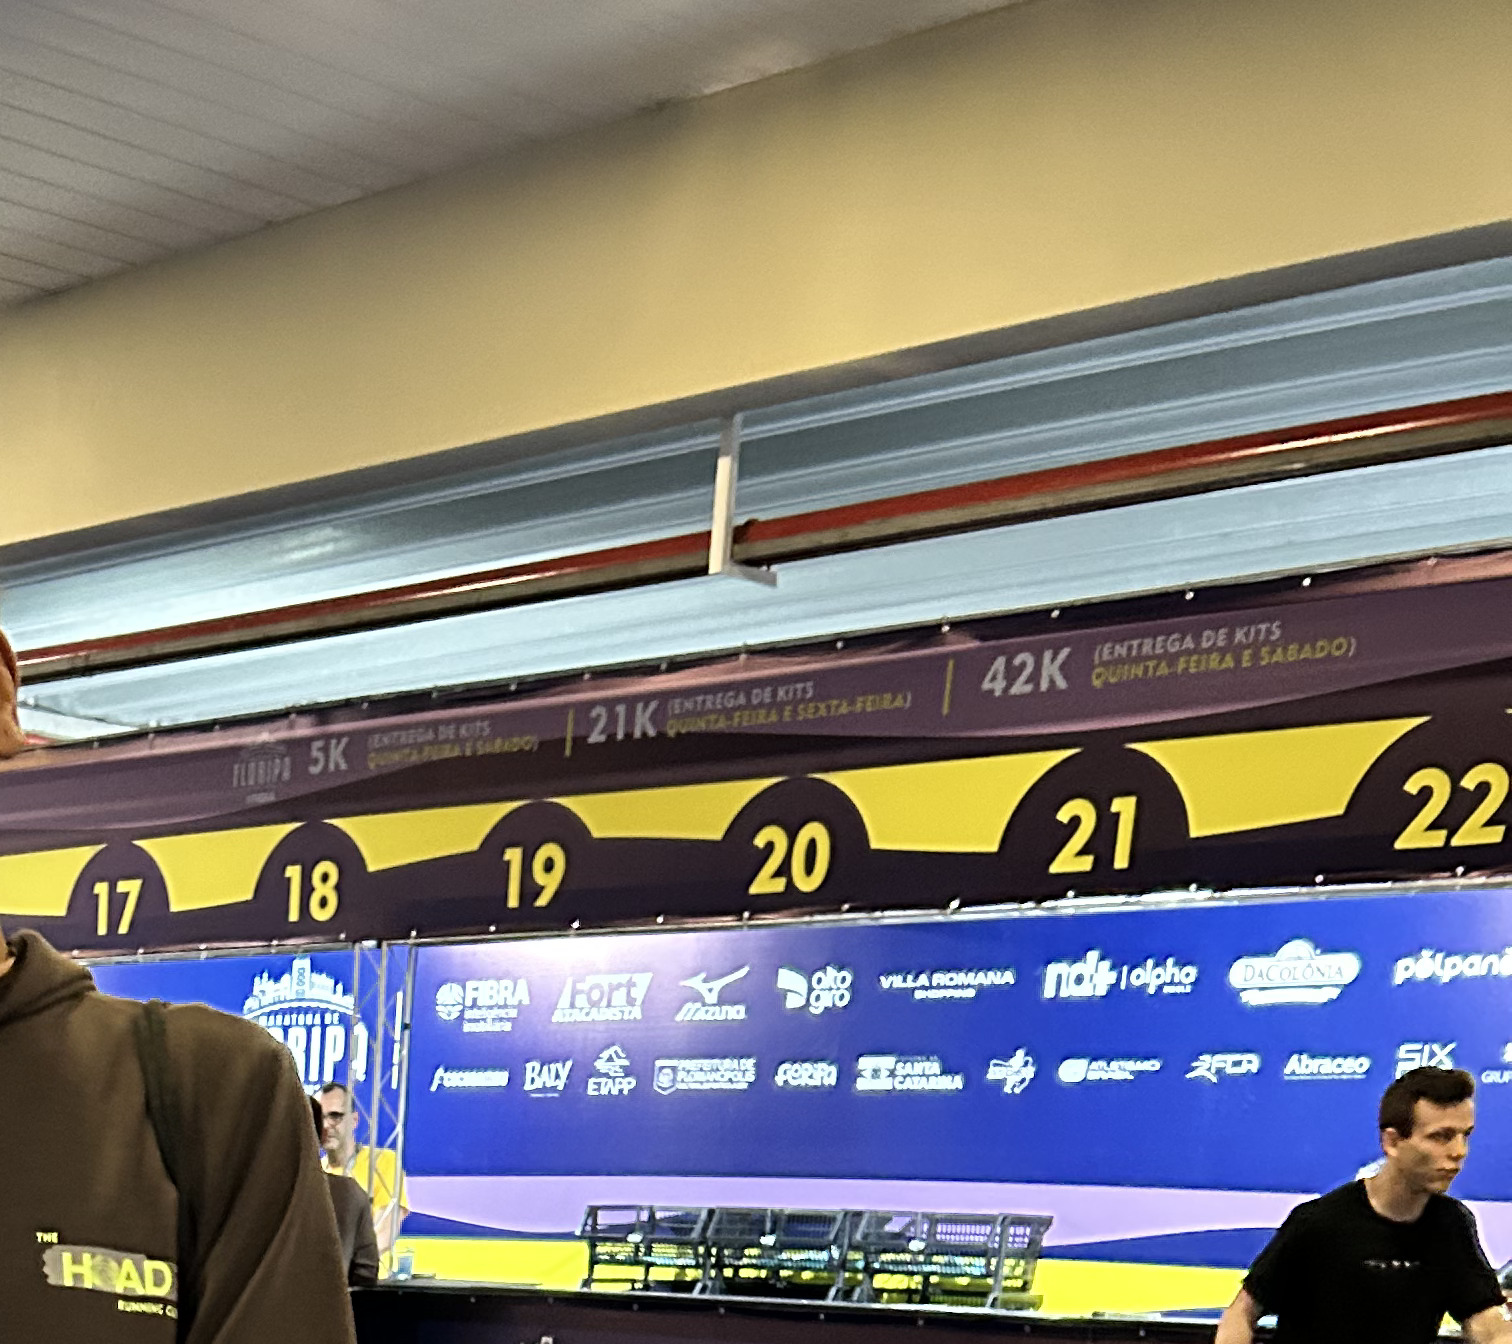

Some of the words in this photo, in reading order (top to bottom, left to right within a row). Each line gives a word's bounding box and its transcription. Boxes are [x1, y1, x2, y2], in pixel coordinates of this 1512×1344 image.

[1201, 628, 1229, 649] DE
[1235, 621, 1282, 644] KITS
[981, 647, 1072, 697] 42K
[1241, 650, 1253, 667] E
[751, 687, 772, 705] DE
[777, 681, 814, 701] KITS
[588, 700, 660, 744] 21K
[308, 737, 350, 775] 5K
[1393, 762, 1510, 850] 22
[1048, 795, 1138, 875] 21
[501, 842, 568, 910] 19
[747, 821, 831, 896] 20
[93, 879, 144, 936] 17
[283, 860, 340, 923] 18
[464, 978, 531, 1007] FIBRA
[879, 973, 930, 989] VILLA
[931, 970, 1015, 988] ROMANA
[524, 1060, 572, 1091] BALY
[36, 1231, 58, 1244] THE
